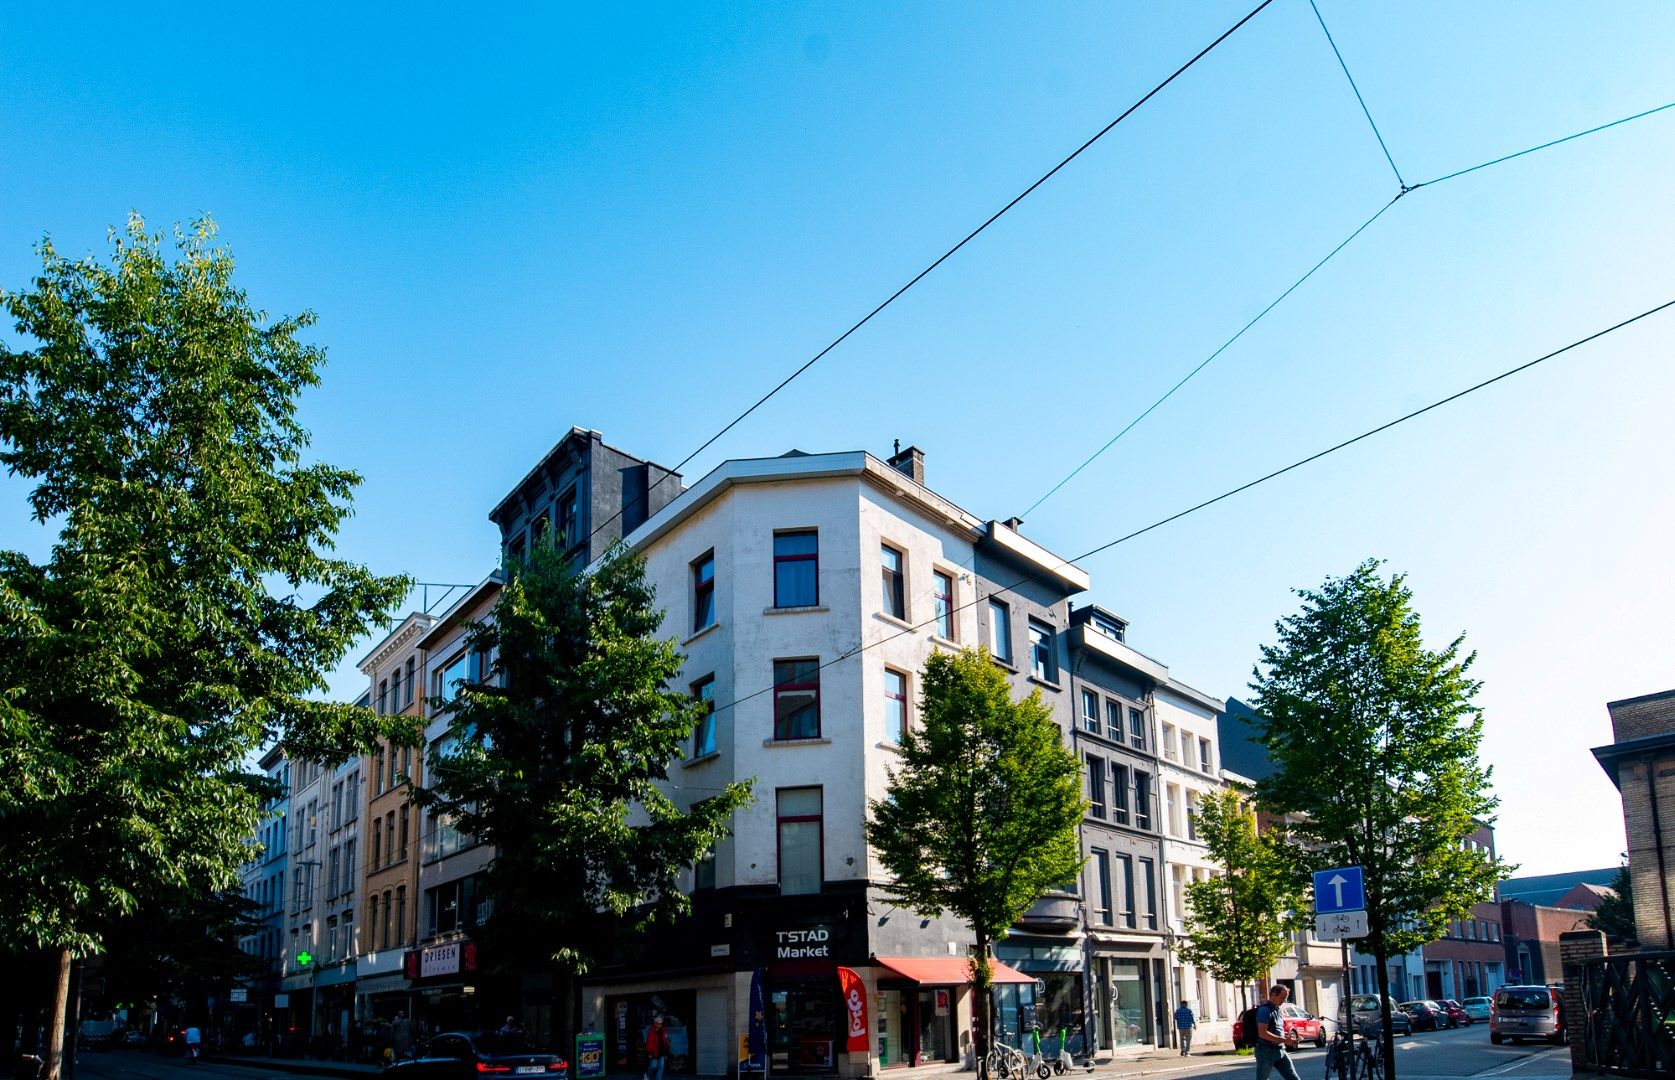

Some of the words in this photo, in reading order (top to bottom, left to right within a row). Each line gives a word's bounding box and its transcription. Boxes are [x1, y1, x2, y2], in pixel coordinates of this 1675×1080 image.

[776, 930, 828, 943] T'STAD
[425, 947, 456, 963] DRIESEN
[777, 945, 829, 958] Market
